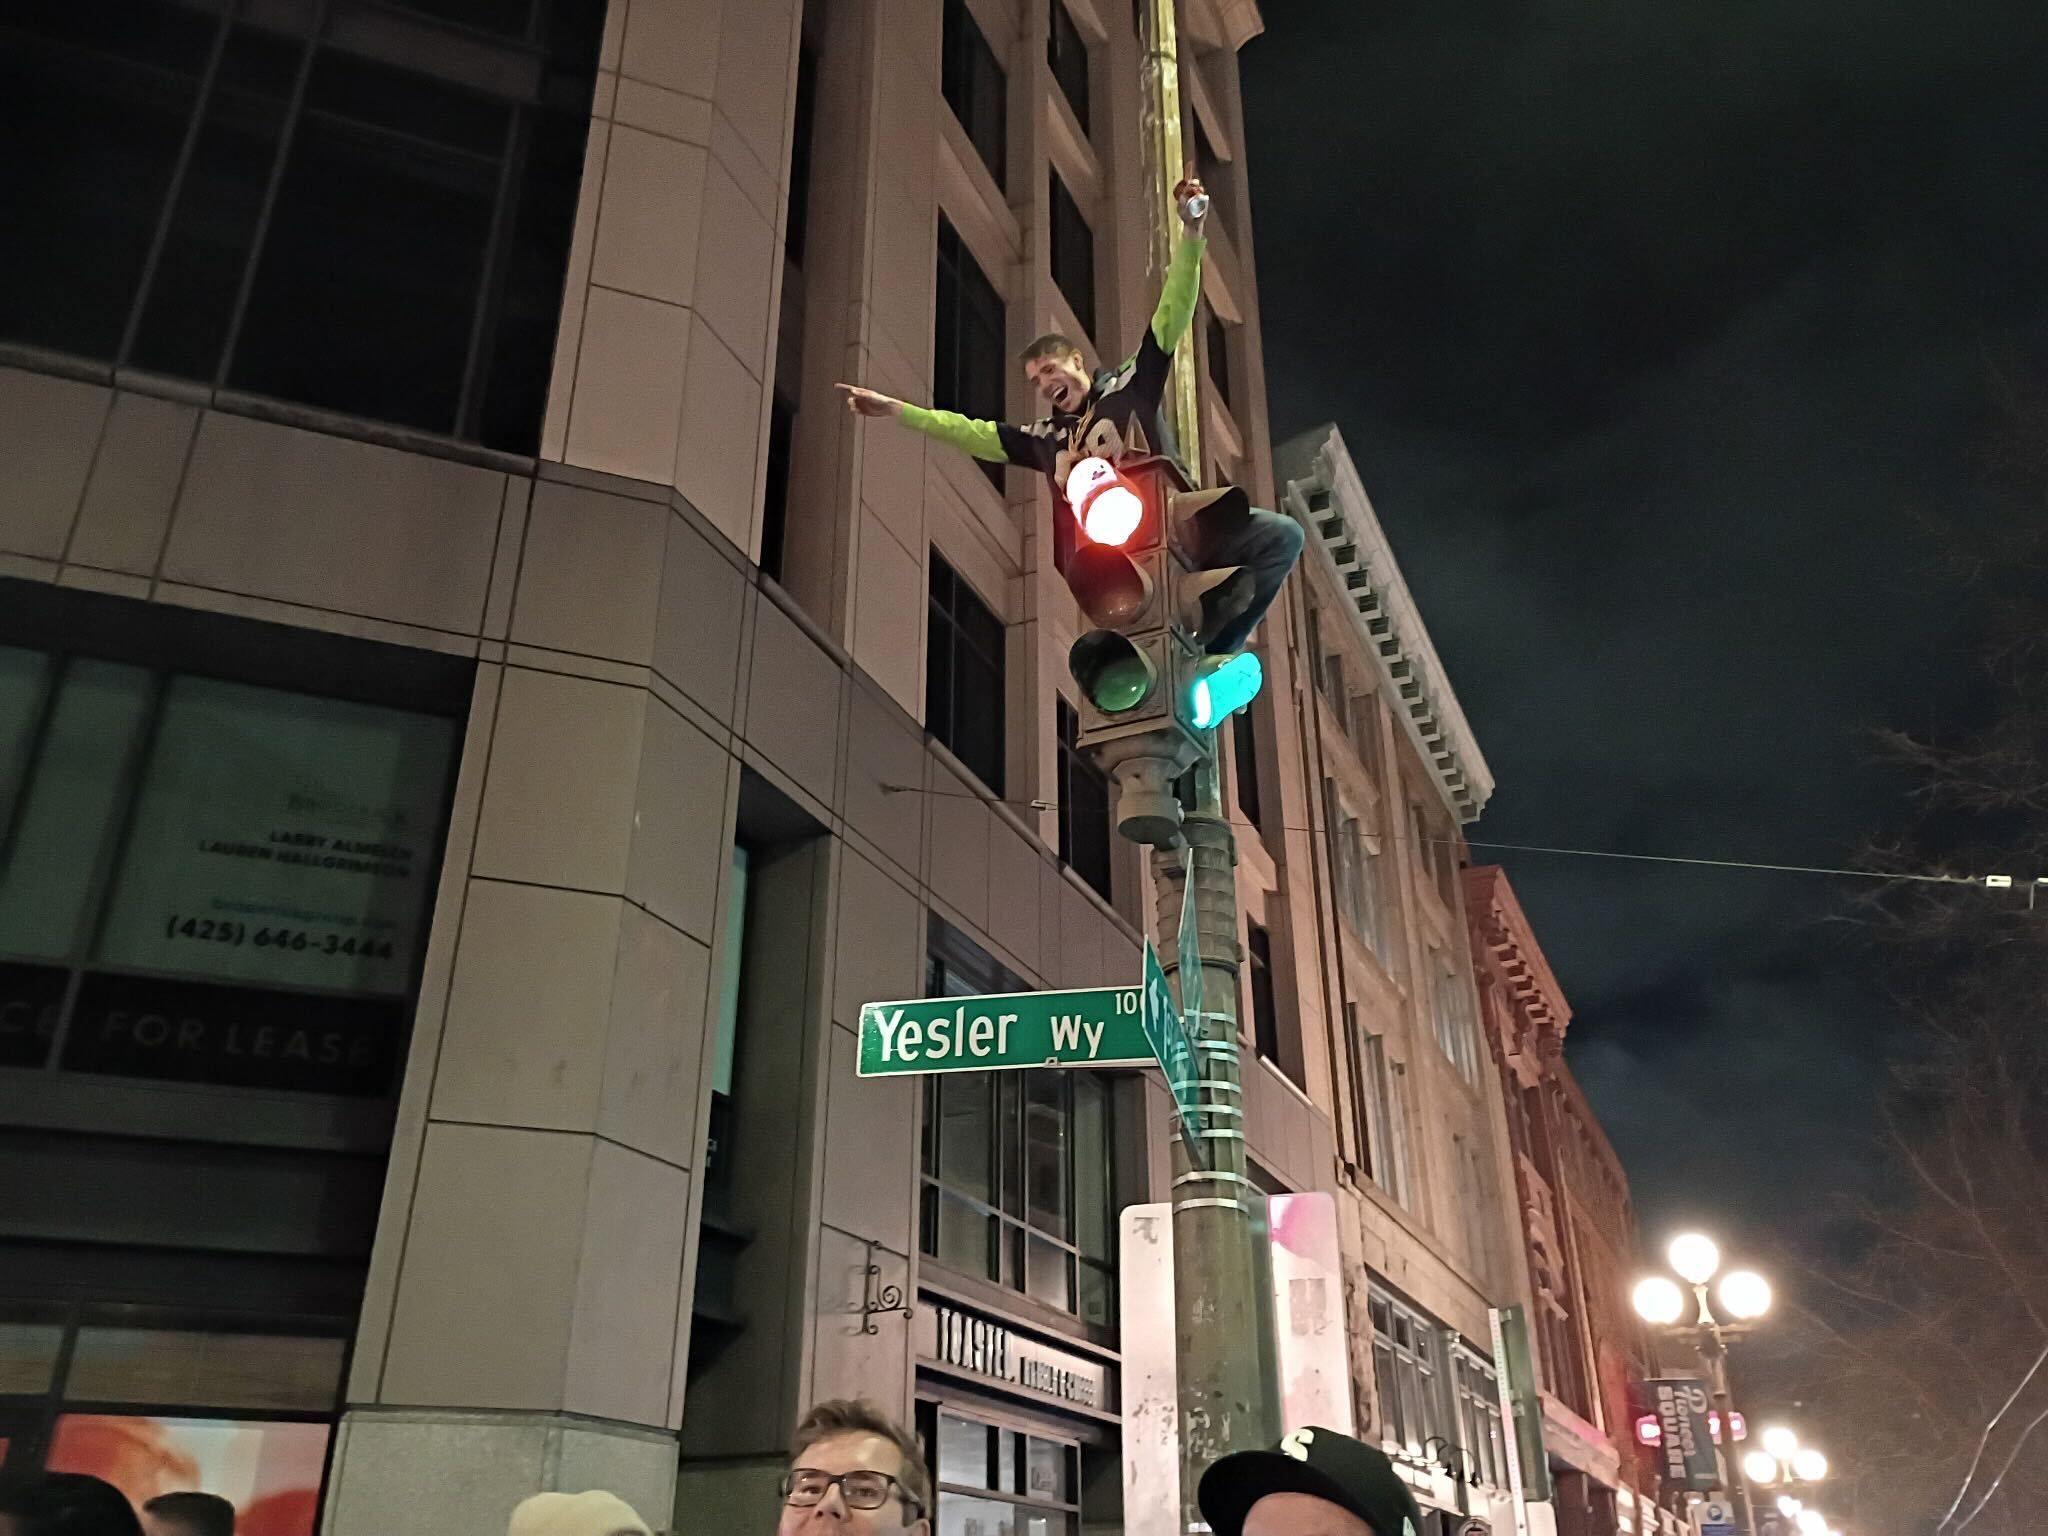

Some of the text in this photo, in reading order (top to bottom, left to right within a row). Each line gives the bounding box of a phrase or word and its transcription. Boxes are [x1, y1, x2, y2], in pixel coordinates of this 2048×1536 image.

[166, 915, 393, 960] (425) 646-3444
[1115, 991, 1145, 1015] 10
[101, 1010, 206, 1051] FOR
[224, 1021, 374, 1068] LEASE
[873, 1006, 1105, 1062] Yesler Wy
